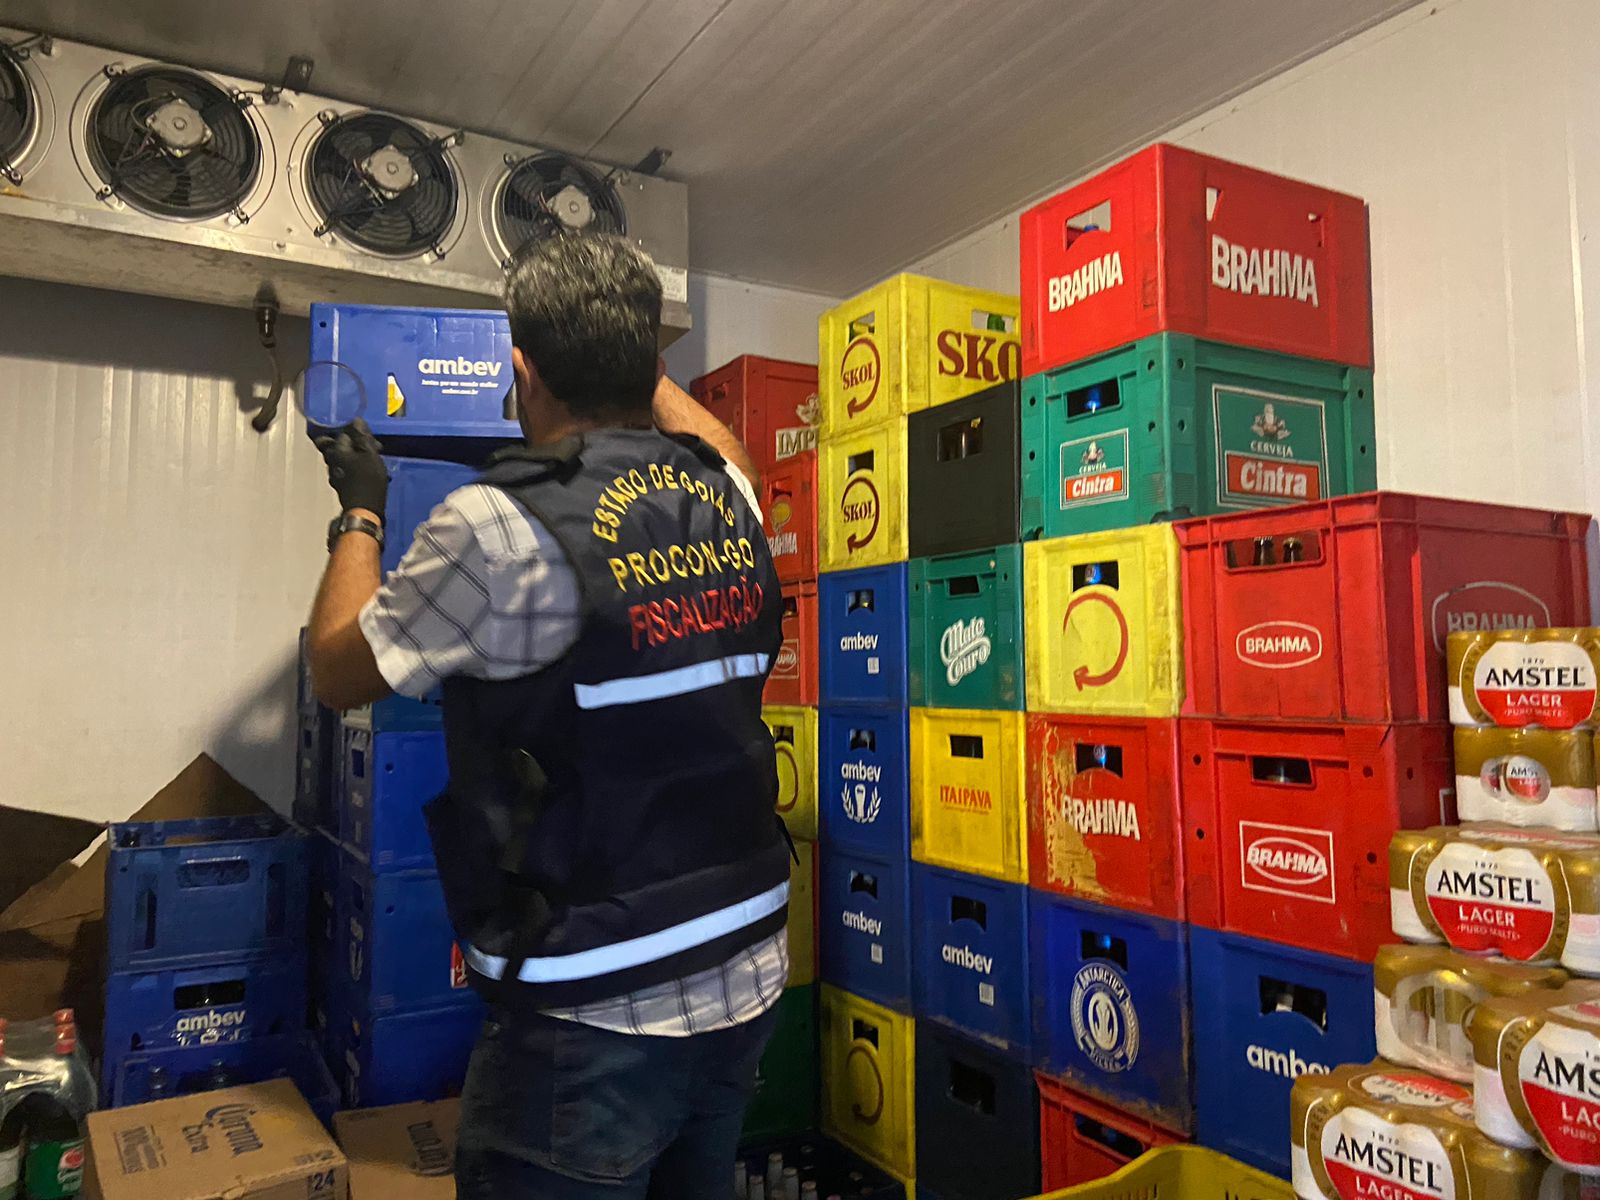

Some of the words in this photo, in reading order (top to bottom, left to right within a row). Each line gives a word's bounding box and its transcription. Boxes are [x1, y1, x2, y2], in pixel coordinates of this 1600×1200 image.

[1049, 251, 1124, 312] BRAHMA
[1211, 234, 1319, 307] BRAHMA
[418, 356, 502, 377] ambev
[842, 362, 875, 390] SKOL
[1250, 441, 1294, 458] CERVEJA
[1072, 475, 1115, 498] Cintra
[1240, 461, 1307, 497] Cintra
[592, 468, 649, 544] ESTADO
[648, 463, 680, 491] DE
[843, 503, 875, 524] SKOL
[607, 537, 755, 593] PROCON-GO
[628, 575, 764, 651] FISCALIZAÇÃO
[840, 633, 879, 652] ambev
[1245, 637, 1312, 653] BRAHMA
[1485, 667, 1587, 687] AMSTEL
[1506, 693, 1562, 707] LAGER
[841, 759, 881, 783] ambev
[940, 784, 992, 810] ITAIPAVA
[1061, 795, 1140, 840] BRAHMA
[1247, 846, 1328, 877] BRAHMA
[1437, 869, 1542, 905] AMSTEL
[842, 909, 882, 936] ambev
[1458, 905, 1515, 928] LAGER
[942, 943, 993, 975] ambev
[176, 1009, 246, 1033] ambev
[1334, 1132, 1442, 1192] AMSTEL
[315, 1169, 334, 1191] 24
[1356, 1175, 1413, 1200] LAGER
